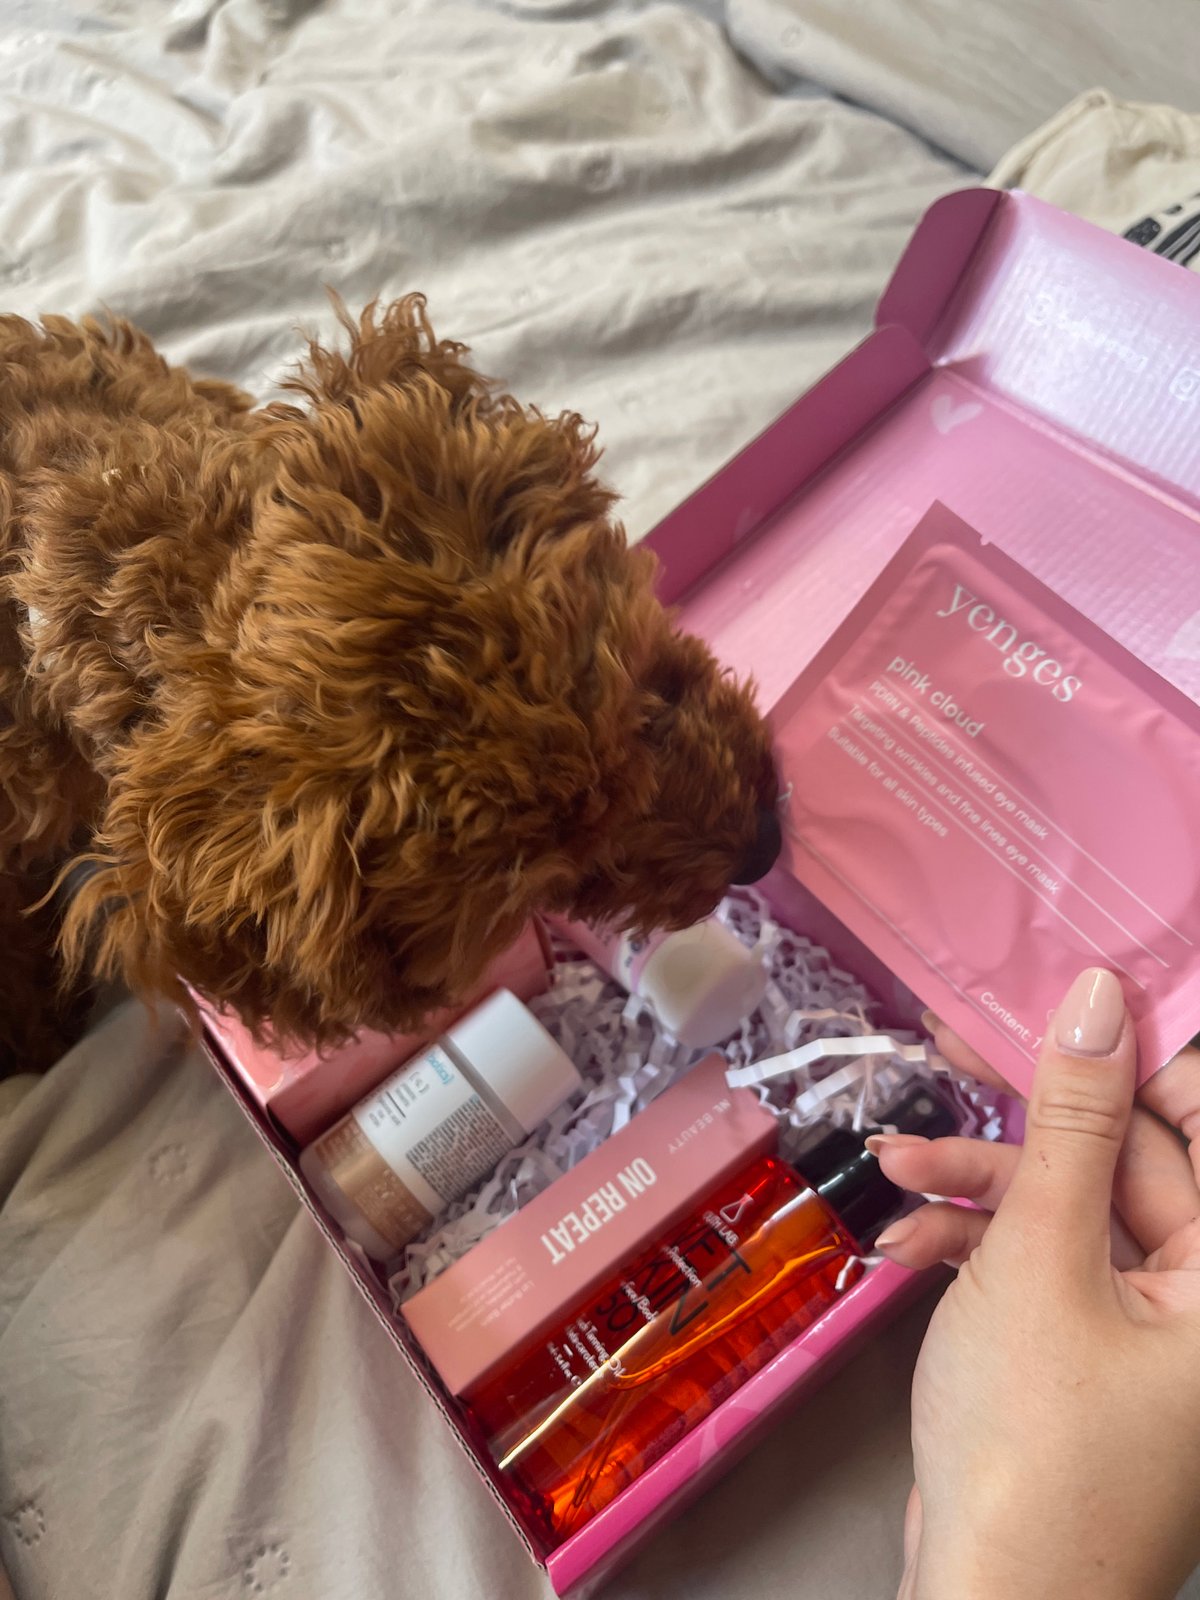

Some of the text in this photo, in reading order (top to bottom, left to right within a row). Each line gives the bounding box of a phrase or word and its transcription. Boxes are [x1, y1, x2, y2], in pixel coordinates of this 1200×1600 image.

[935, 583, 1084, 704] yenges
[888, 654, 983, 736] pink cloud
[827, 728, 948, 837] Suitable for all skin types
[847, 705, 1058, 893] Targeting wrinkles and fine lines eye mask
[869, 682, 898, 709] PDRN
[907, 717, 954, 759] Peptides
[953, 756, 995, 793] infused
[993, 793, 1014, 813] eye
[1015, 809, 1047, 838] mask
[978, 991, 1033, 1040] Content:
[666, 1113, 712, 1152] BEAUTY
[538, 1157, 656, 1263] ON REPEAT
[666, 1246, 701, 1287] Protection
[585, 1326, 609, 1362] Tanning
